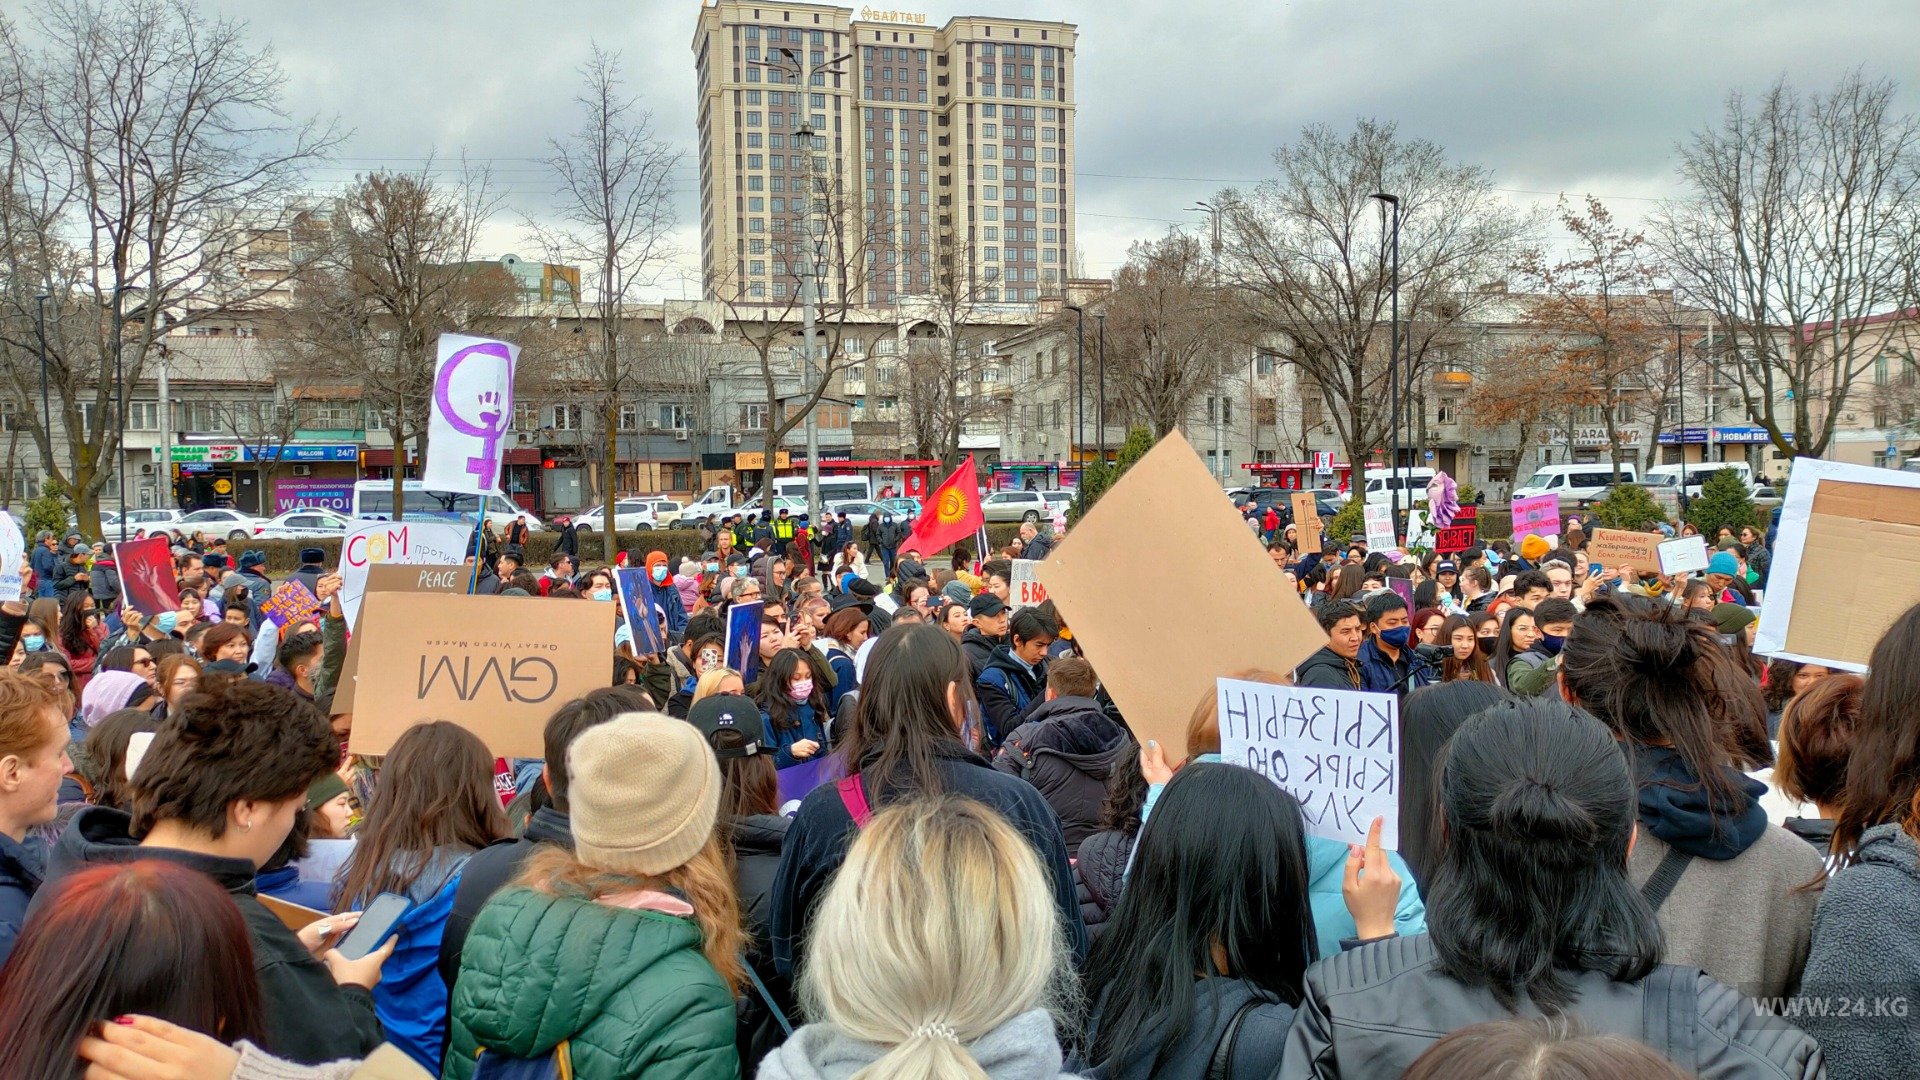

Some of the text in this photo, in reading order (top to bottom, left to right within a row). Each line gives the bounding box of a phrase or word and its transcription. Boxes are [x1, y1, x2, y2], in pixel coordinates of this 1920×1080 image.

[873, 10, 925, 23] БАЙТАШ
[1723, 432, 1769, 441] НОВЫЙ ВЕК
[336, 449, 355, 457] 24/7
[280, 498, 350, 510] WALCOI
[417, 570, 458, 589] PEACE
[417, 654, 558, 704] GVM
